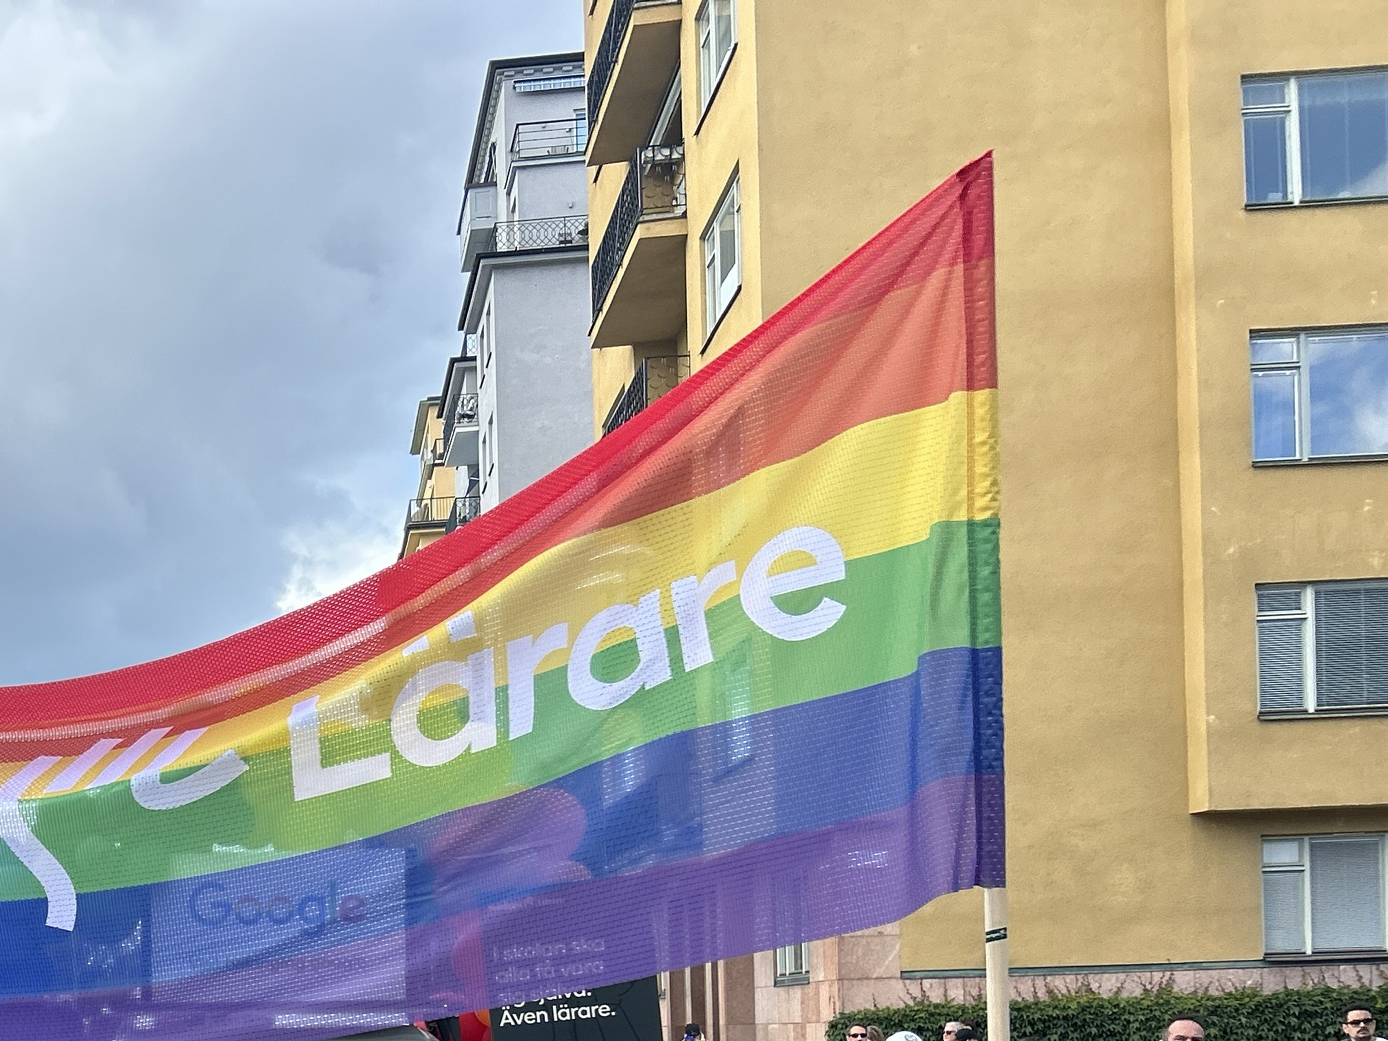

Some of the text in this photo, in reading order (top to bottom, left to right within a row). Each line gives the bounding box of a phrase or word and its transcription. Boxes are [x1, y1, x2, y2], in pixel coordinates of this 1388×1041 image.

[288, 525, 848, 801] Lärare
[189, 878, 368, 934] Google
[499, 1003, 616, 1027] Även lärare.
